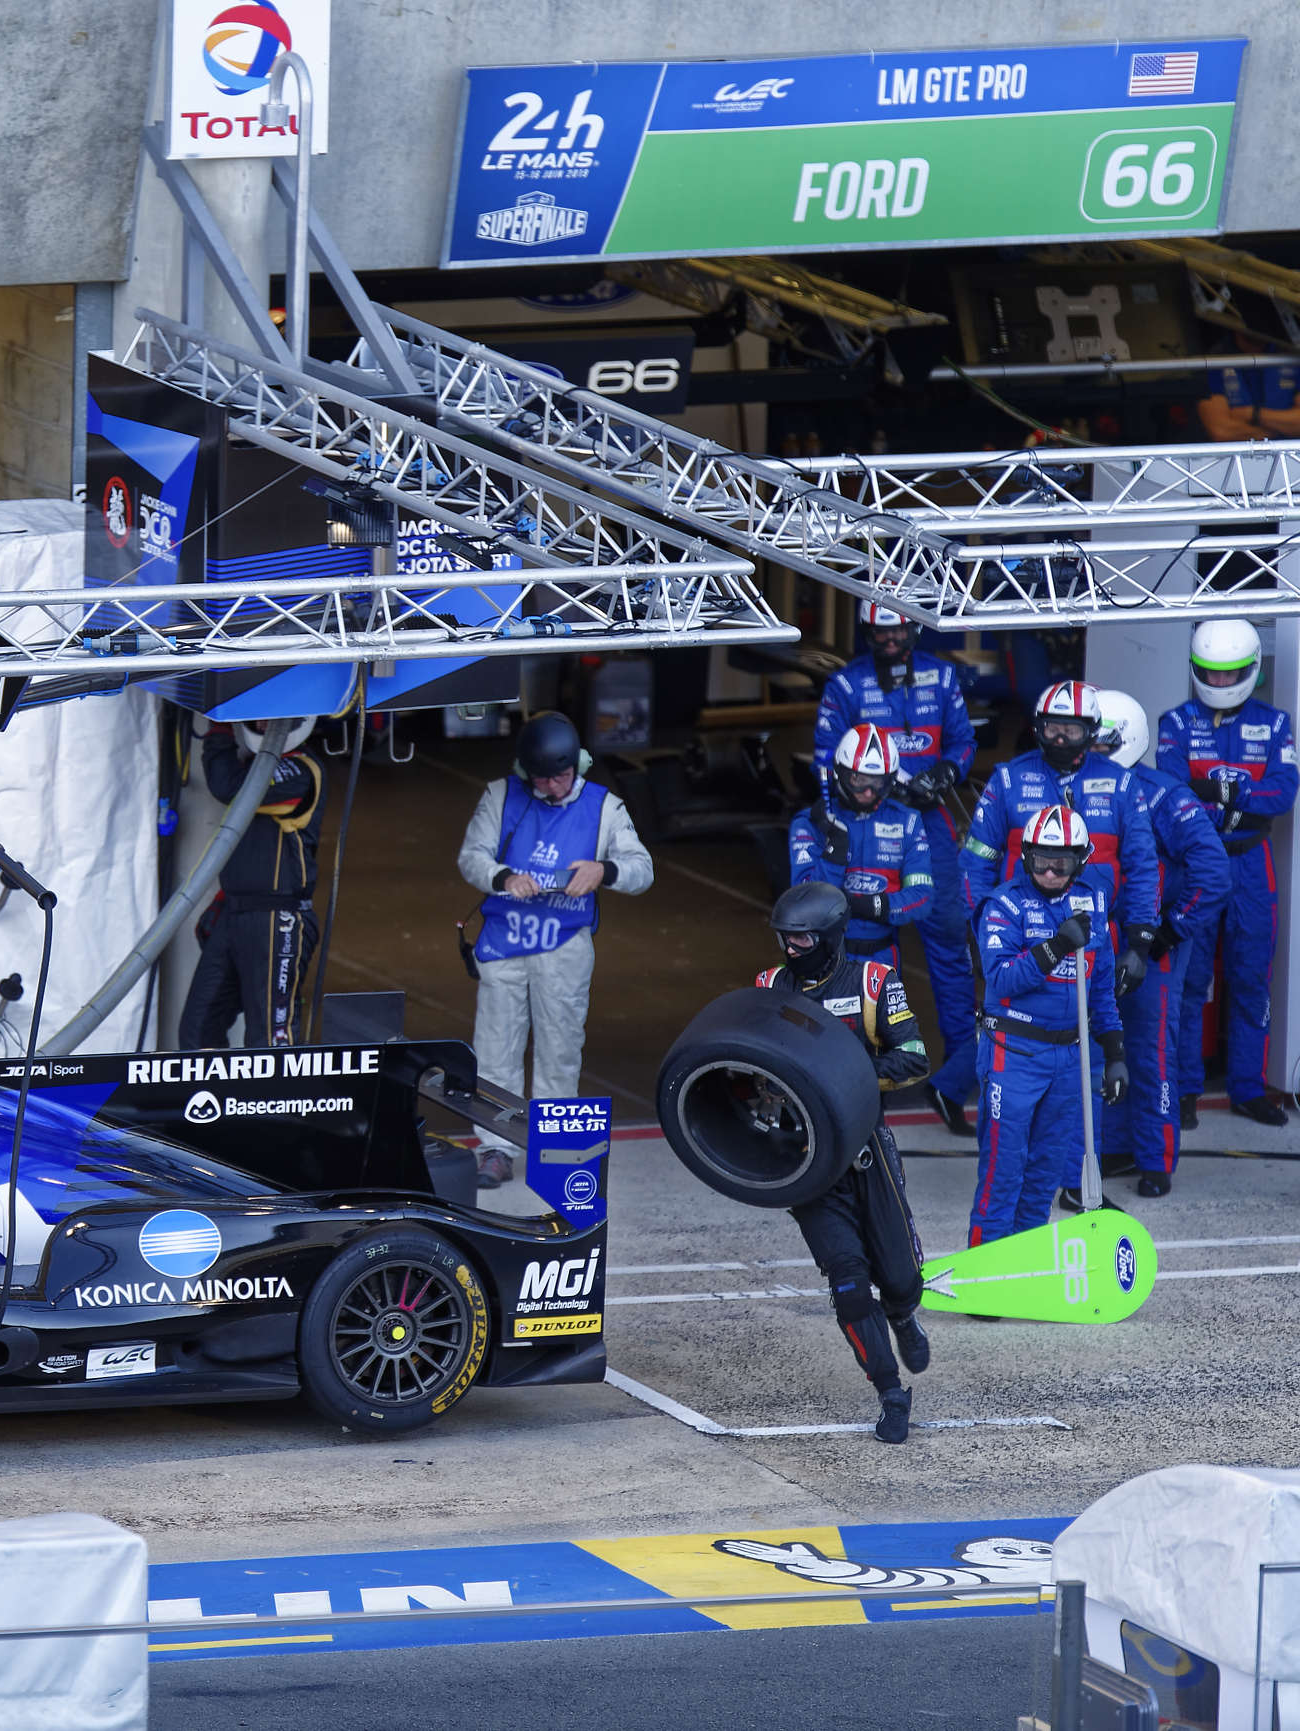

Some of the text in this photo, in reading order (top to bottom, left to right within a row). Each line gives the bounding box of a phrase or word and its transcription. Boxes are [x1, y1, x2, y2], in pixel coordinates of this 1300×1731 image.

[714, 78, 795, 102] WEC
[877, 62, 1028, 107] LM GTE PRO
[488, 89, 605, 152] 24h
[481, 152, 595, 170] LE MANS
[1101, 140, 1197, 209] 66
[792, 157, 931, 223] FORD
[478, 204, 587, 243] SUPERFINALE
[587, 358, 680, 395] 66
[844, 873, 881, 893] Ford
[506, 911, 562, 951] 930
[53, 1064, 84, 1077] Sport
[127, 1049, 381, 1085] RICHARD MILLE
[224, 1095, 354, 1117] Basecamp.com
[538, 1103, 608, 1118] TOTAL
[990, 1082, 1002, 1120] FORD
[1159, 1082, 1171, 1115] FORD
[537, 1118, 608, 1134] 道达尔
[1062, 1237, 1089, 1305] 66
[1117, 1245, 1134, 1284] Ford
[74, 1276, 294, 1308] KONICA MINOLTA
[516, 1299, 590, 1314] Digital Technology
[530, 1319, 598, 1332] DUNLOP
[102, 1346, 155, 1366] WEC
